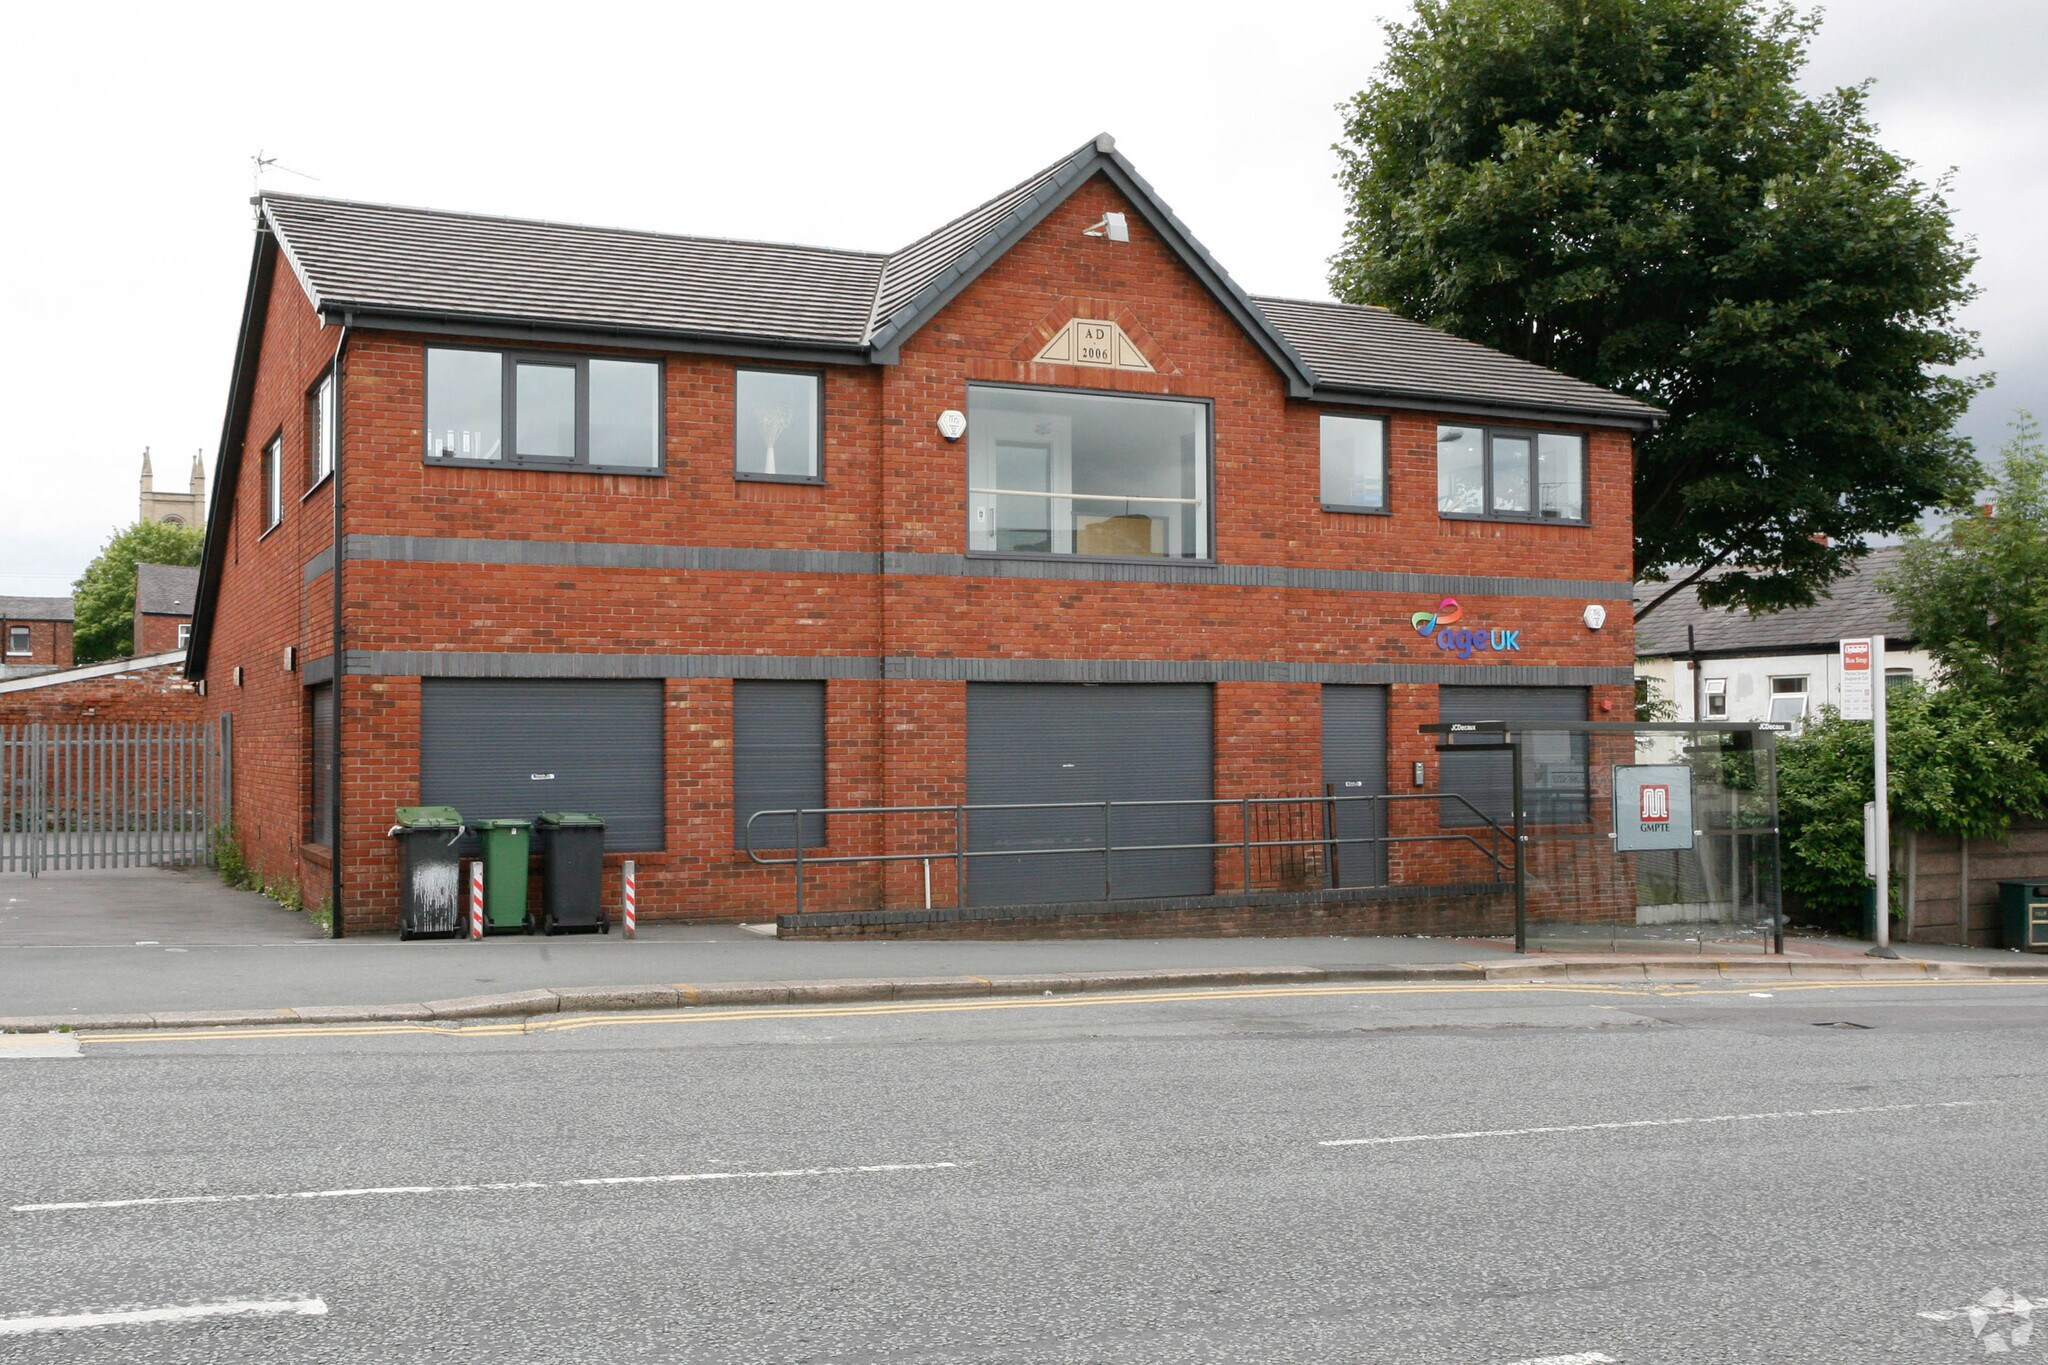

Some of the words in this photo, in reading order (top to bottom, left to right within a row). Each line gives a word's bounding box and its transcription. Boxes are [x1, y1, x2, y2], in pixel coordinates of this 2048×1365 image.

[1082, 347, 1108, 360] 2006
[1855, 656, 1868, 664] Stop
[1640, 823, 1671, 833] GMPTE
